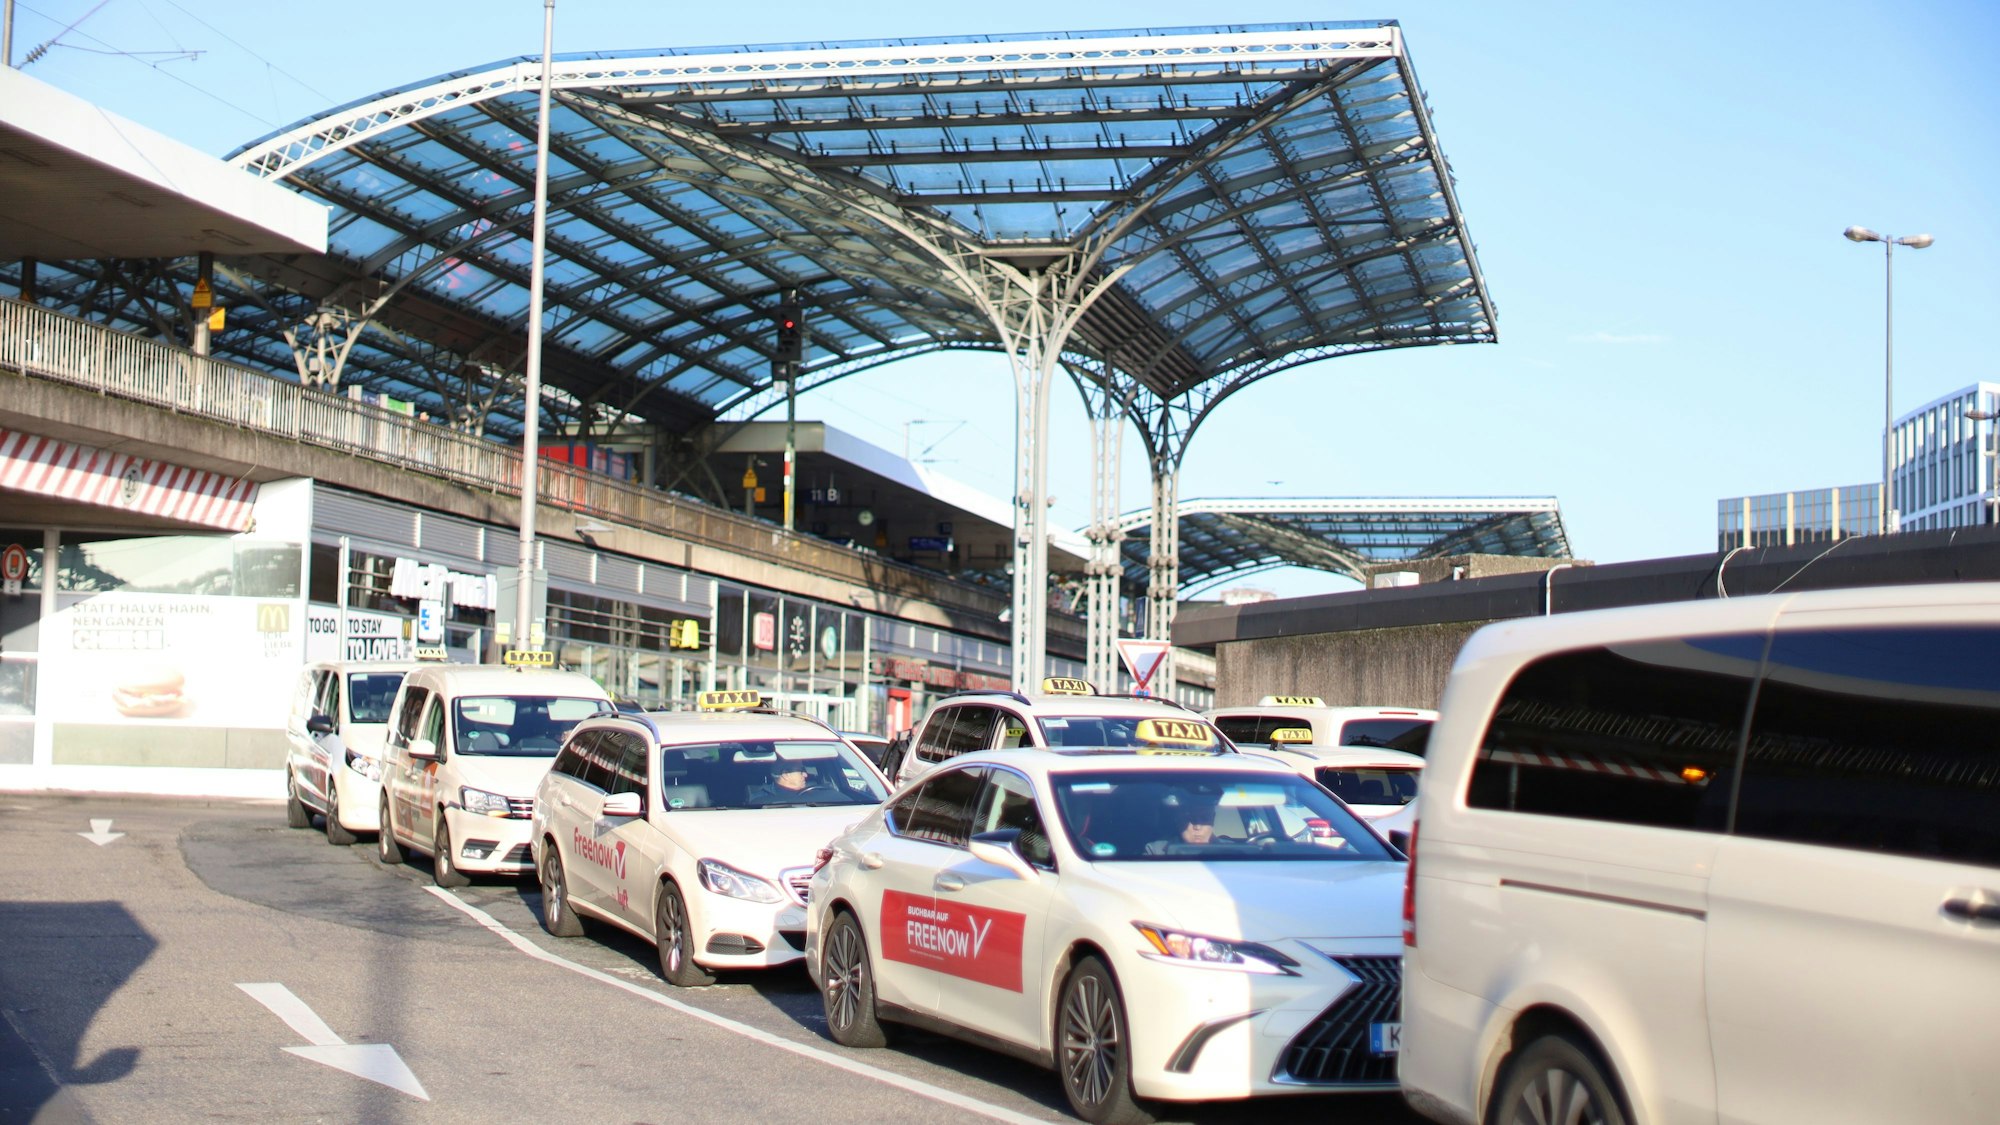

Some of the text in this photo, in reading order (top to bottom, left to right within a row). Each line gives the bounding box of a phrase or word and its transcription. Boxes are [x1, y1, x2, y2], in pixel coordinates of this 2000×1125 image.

[811, 488, 837, 501] 11 B
[73, 603, 113, 614] STATT
[120, 604, 165, 614] HALVE
[73, 616, 164, 627] NEN GANZEN
[309, 618, 320, 633] TO
[348, 619, 382, 634] TO STAY
[348, 638, 366, 661] TO
[515, 653, 547, 662] TAXI
[1053, 679, 1085, 691] TAXI
[711, 692, 752, 704] TAXI
[1156, 721, 1205, 740] TAXI
[1283, 730, 1308, 739] TAXI
[907, 905, 949, 922] BUCHBAR AUF
[907, 919, 970, 958] FREENOW
[1390, 1026, 1402, 1049] K
